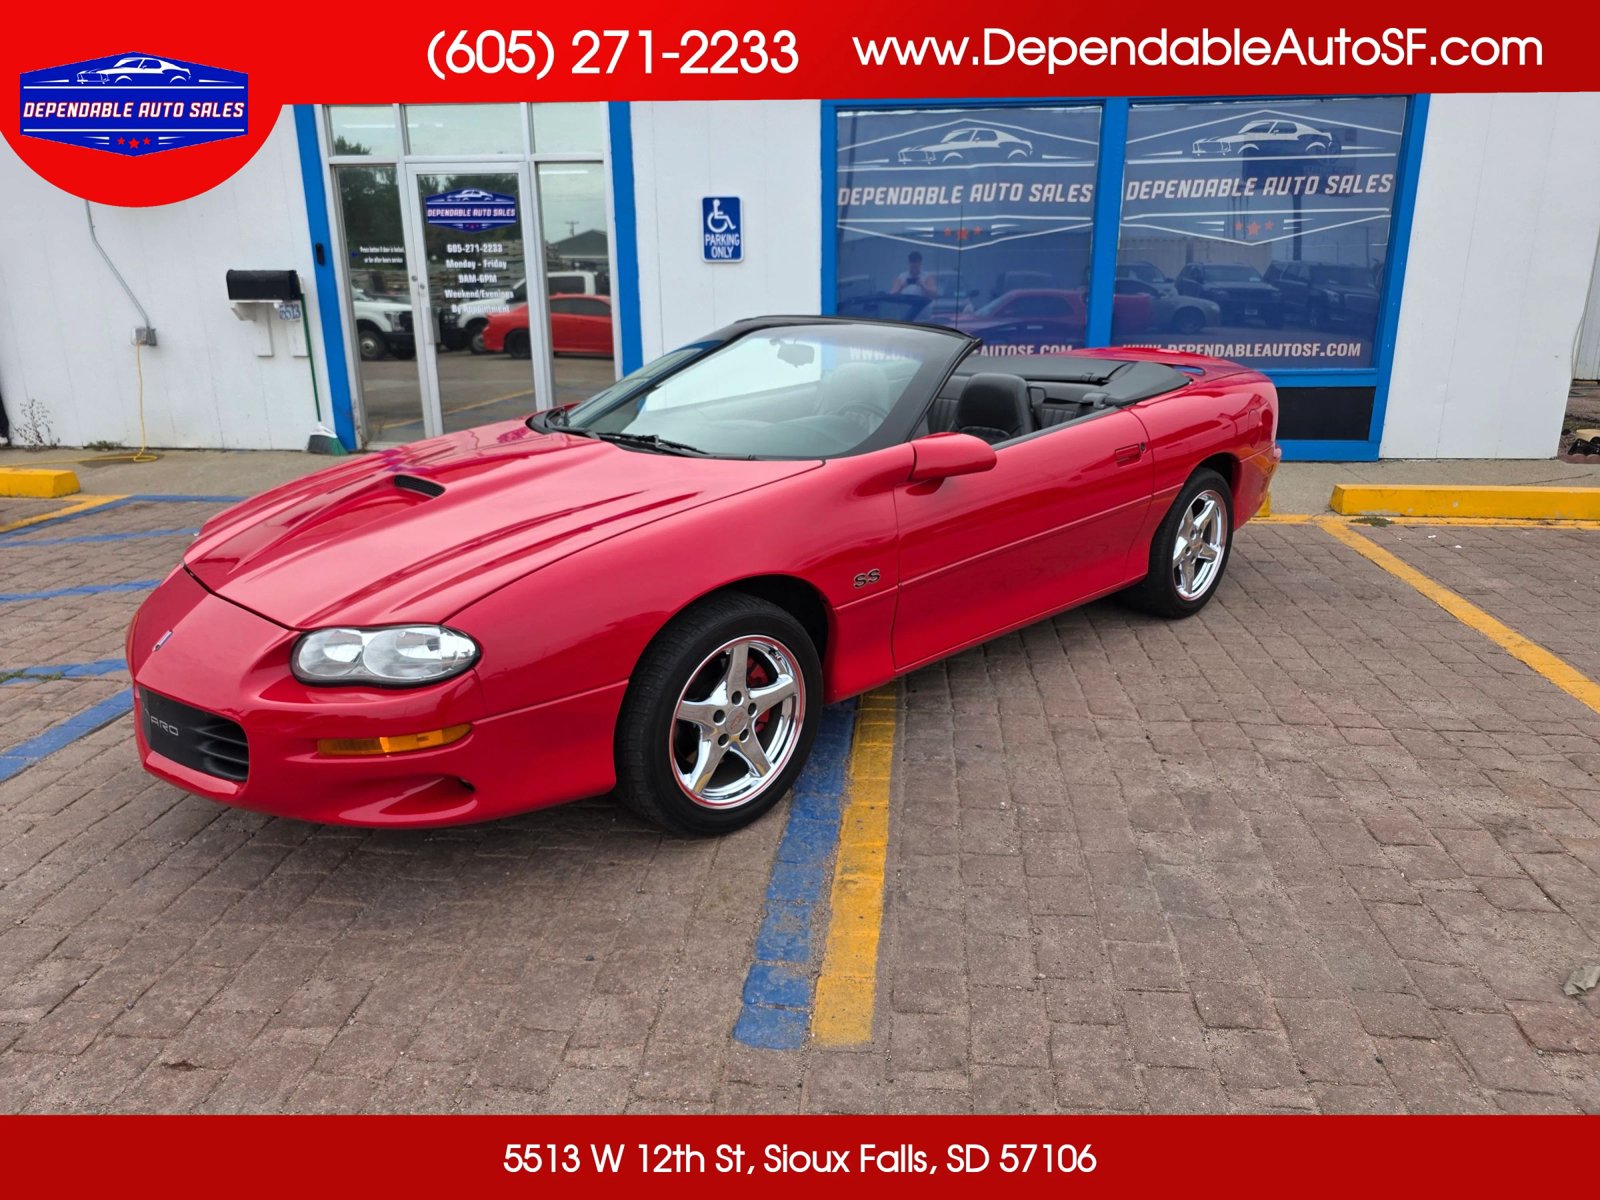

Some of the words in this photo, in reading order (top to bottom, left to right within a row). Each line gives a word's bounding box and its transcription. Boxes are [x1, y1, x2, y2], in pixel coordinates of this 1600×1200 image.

[1125, 177, 1258, 201] DEPENDABLE
[1262, 175, 1320, 196] AUTO
[1324, 173, 1395, 194] SALES
[837, 185, 964, 206] DEPENDABLE
[969, 182, 1024, 202] AUTO
[1028, 183, 1094, 203] SALES
[427, 208, 471, 217] DEPENDABLE
[472, 208, 492, 217] AUTO
[492, 208, 516, 217] SALES
[705, 233, 740, 247] PARKING
[446, 243, 503, 253] 605-271-2233
[711, 246, 734, 258] ONLY
[445, 259, 476, 270] Monday
[483, 259, 507, 270] Friday
[854, 568, 881, 589] SS
